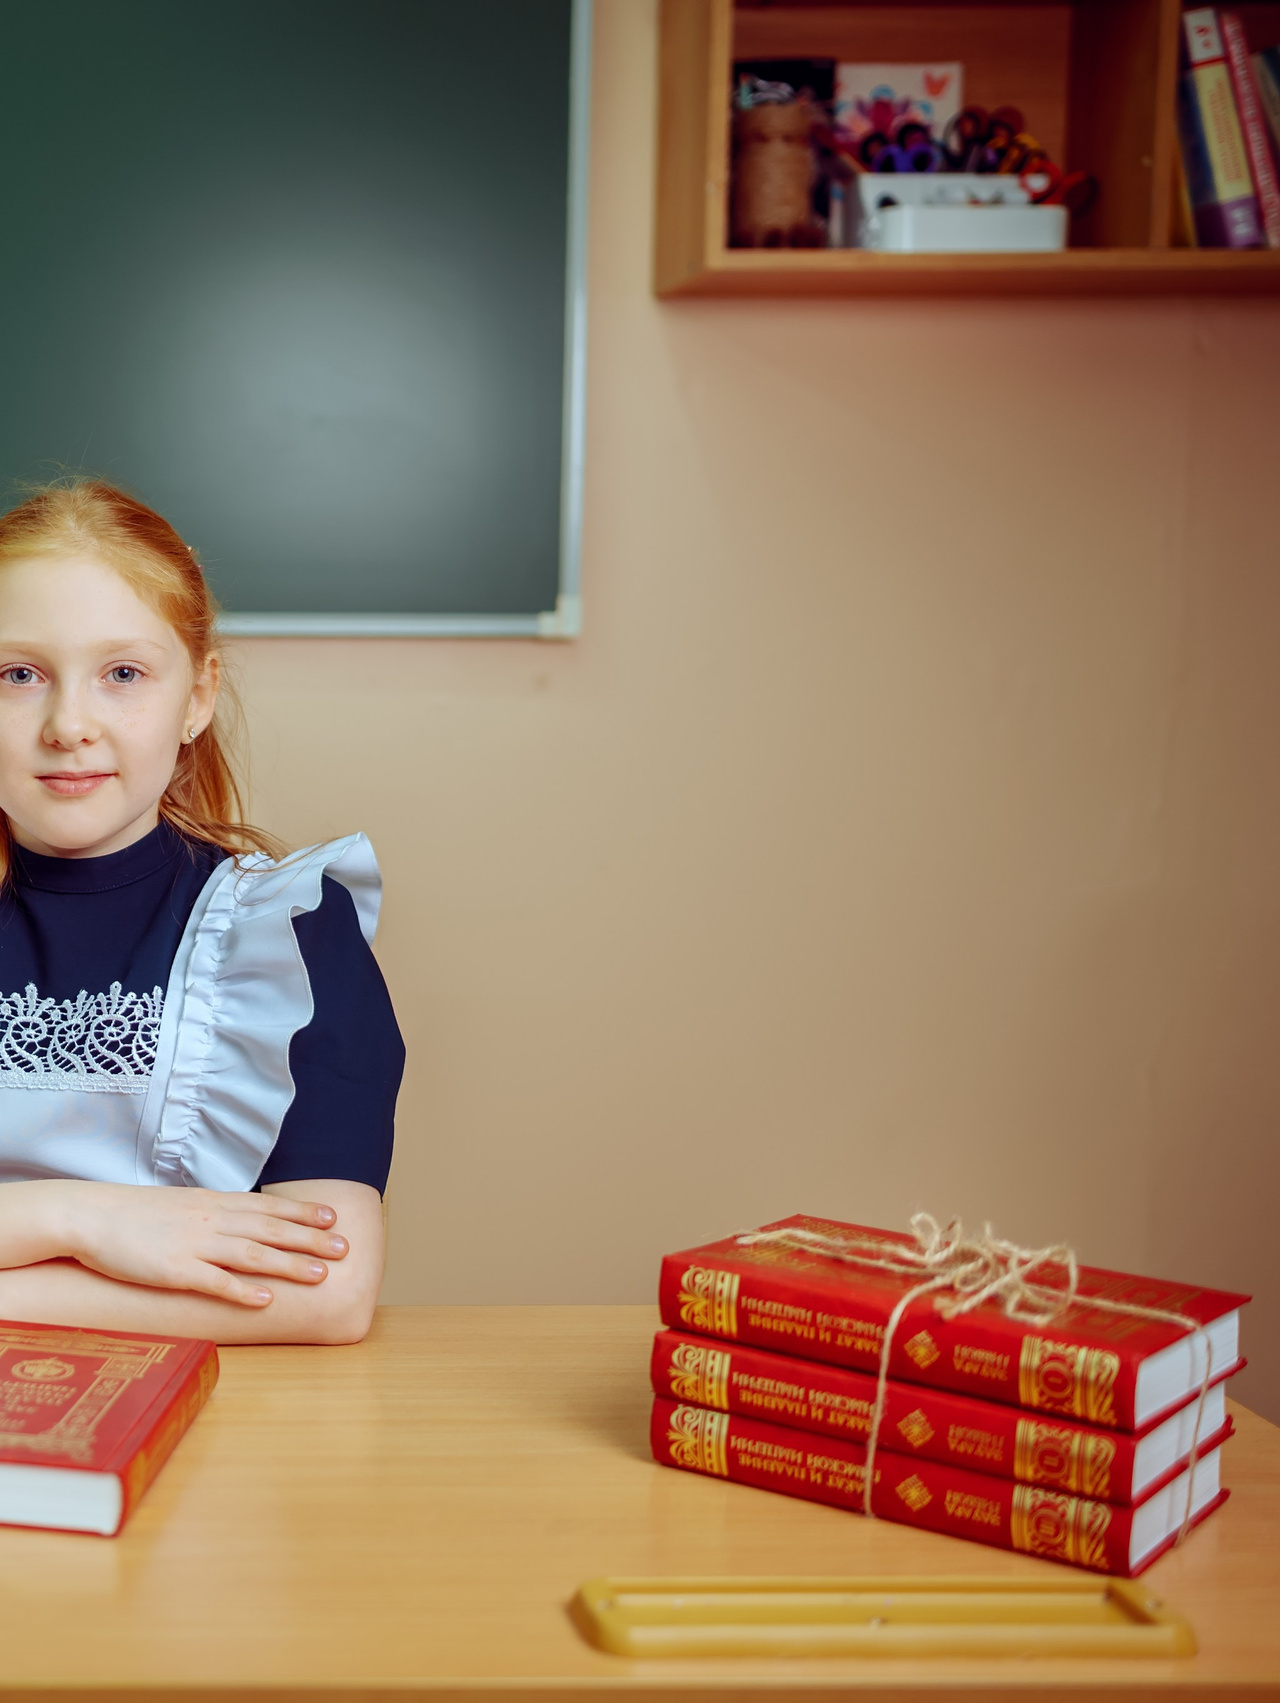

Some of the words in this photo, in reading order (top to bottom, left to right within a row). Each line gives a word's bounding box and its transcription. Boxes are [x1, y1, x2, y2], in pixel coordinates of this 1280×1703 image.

[741, 1296, 813, 1323] ИМПЕРИИ
[749, 1313, 815, 1340] ПАДЕНИЕ
[816, 1312, 887, 1339] ИМСКОЙ
[819, 1328, 831, 1344] И
[732, 1371, 805, 1400] ИМПЕРИИ
[739, 1389, 807, 1417] ПАДЕНИЕ
[808, 1389, 877, 1416] ИМСКОЙ
[811, 1405, 823, 1421] И
[730, 1435, 803, 1464] ИМПЕРИИ
[738, 1452, 806, 1481] ПАДЕНИЕ
[810, 1468, 822, 1485] И
[826, 1474, 867, 1494] АКАТ
